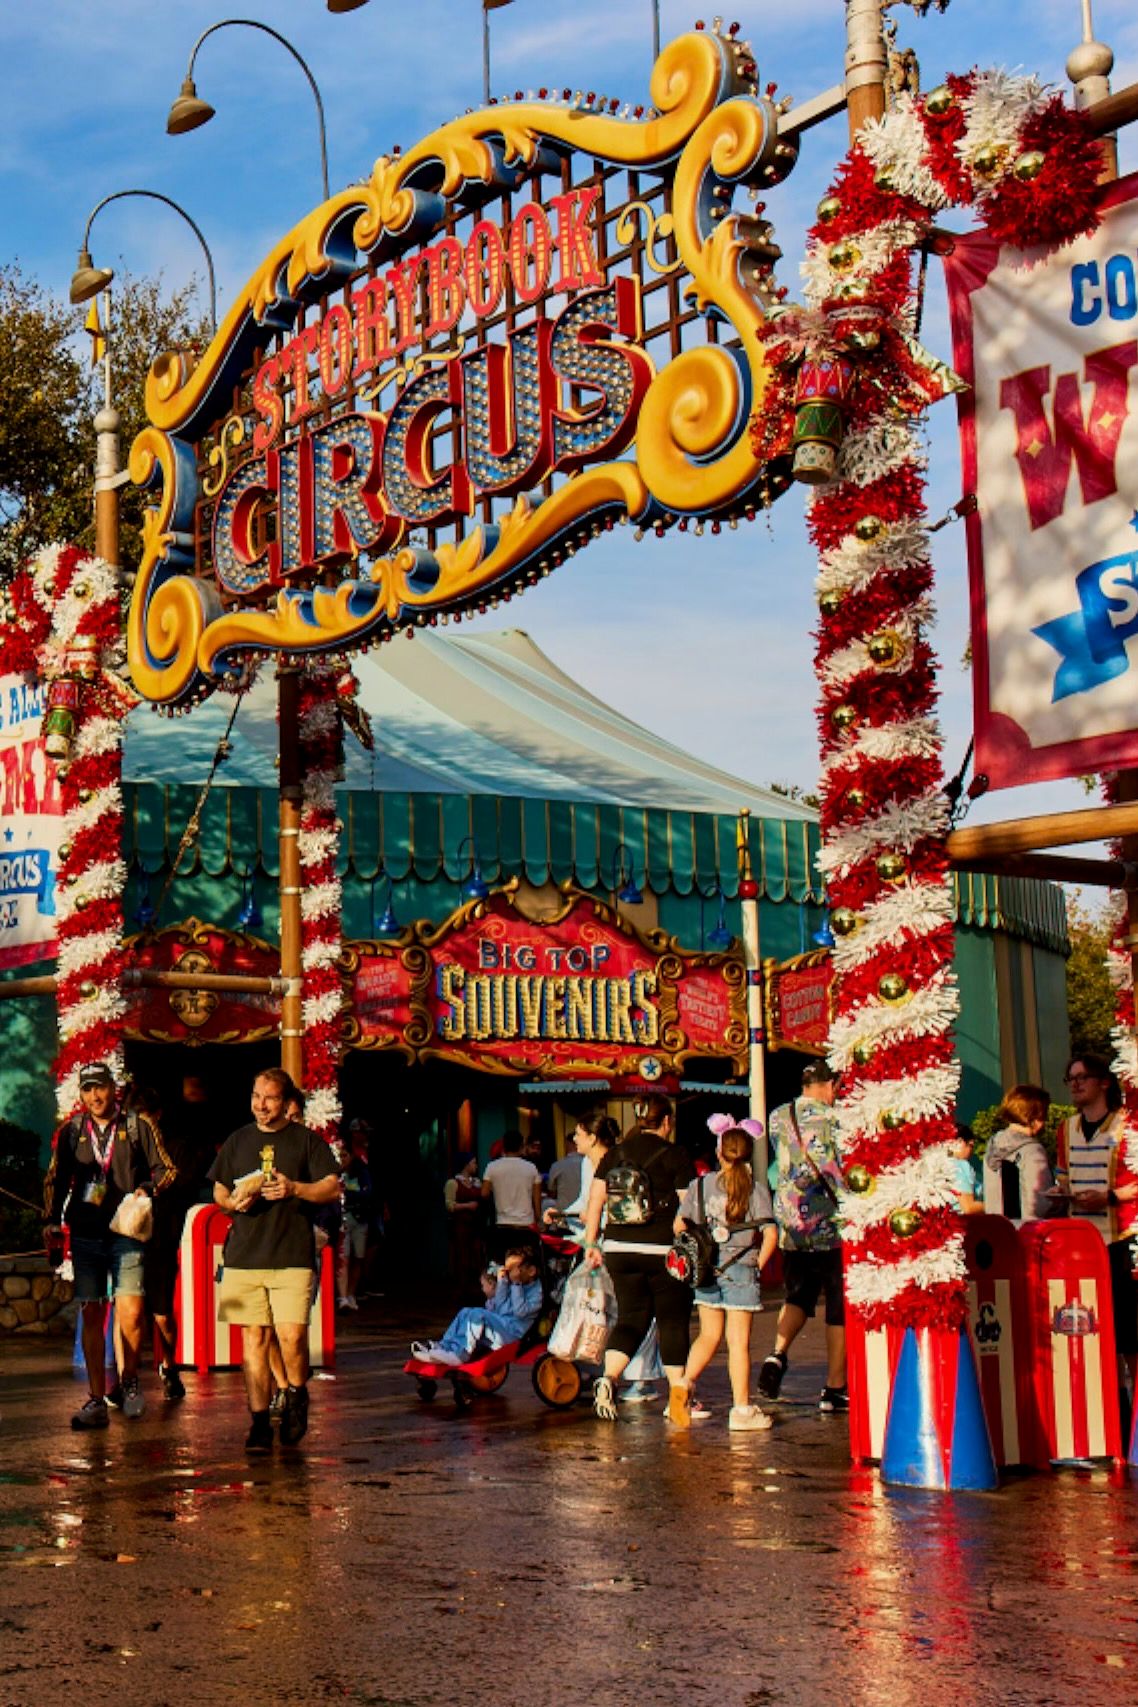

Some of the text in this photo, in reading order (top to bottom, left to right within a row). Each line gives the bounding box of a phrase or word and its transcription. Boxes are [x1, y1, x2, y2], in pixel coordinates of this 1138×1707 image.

[253, 186, 602, 451] STORYBOOK
[212, 275, 656, 595] CIRCUS
[480, 937, 611, 972] BIG TOP
[438, 963, 658, 1046] SOUVENIRS
[783, 985, 825, 1009] COTTON
[786, 1002, 822, 1028] CANDY
